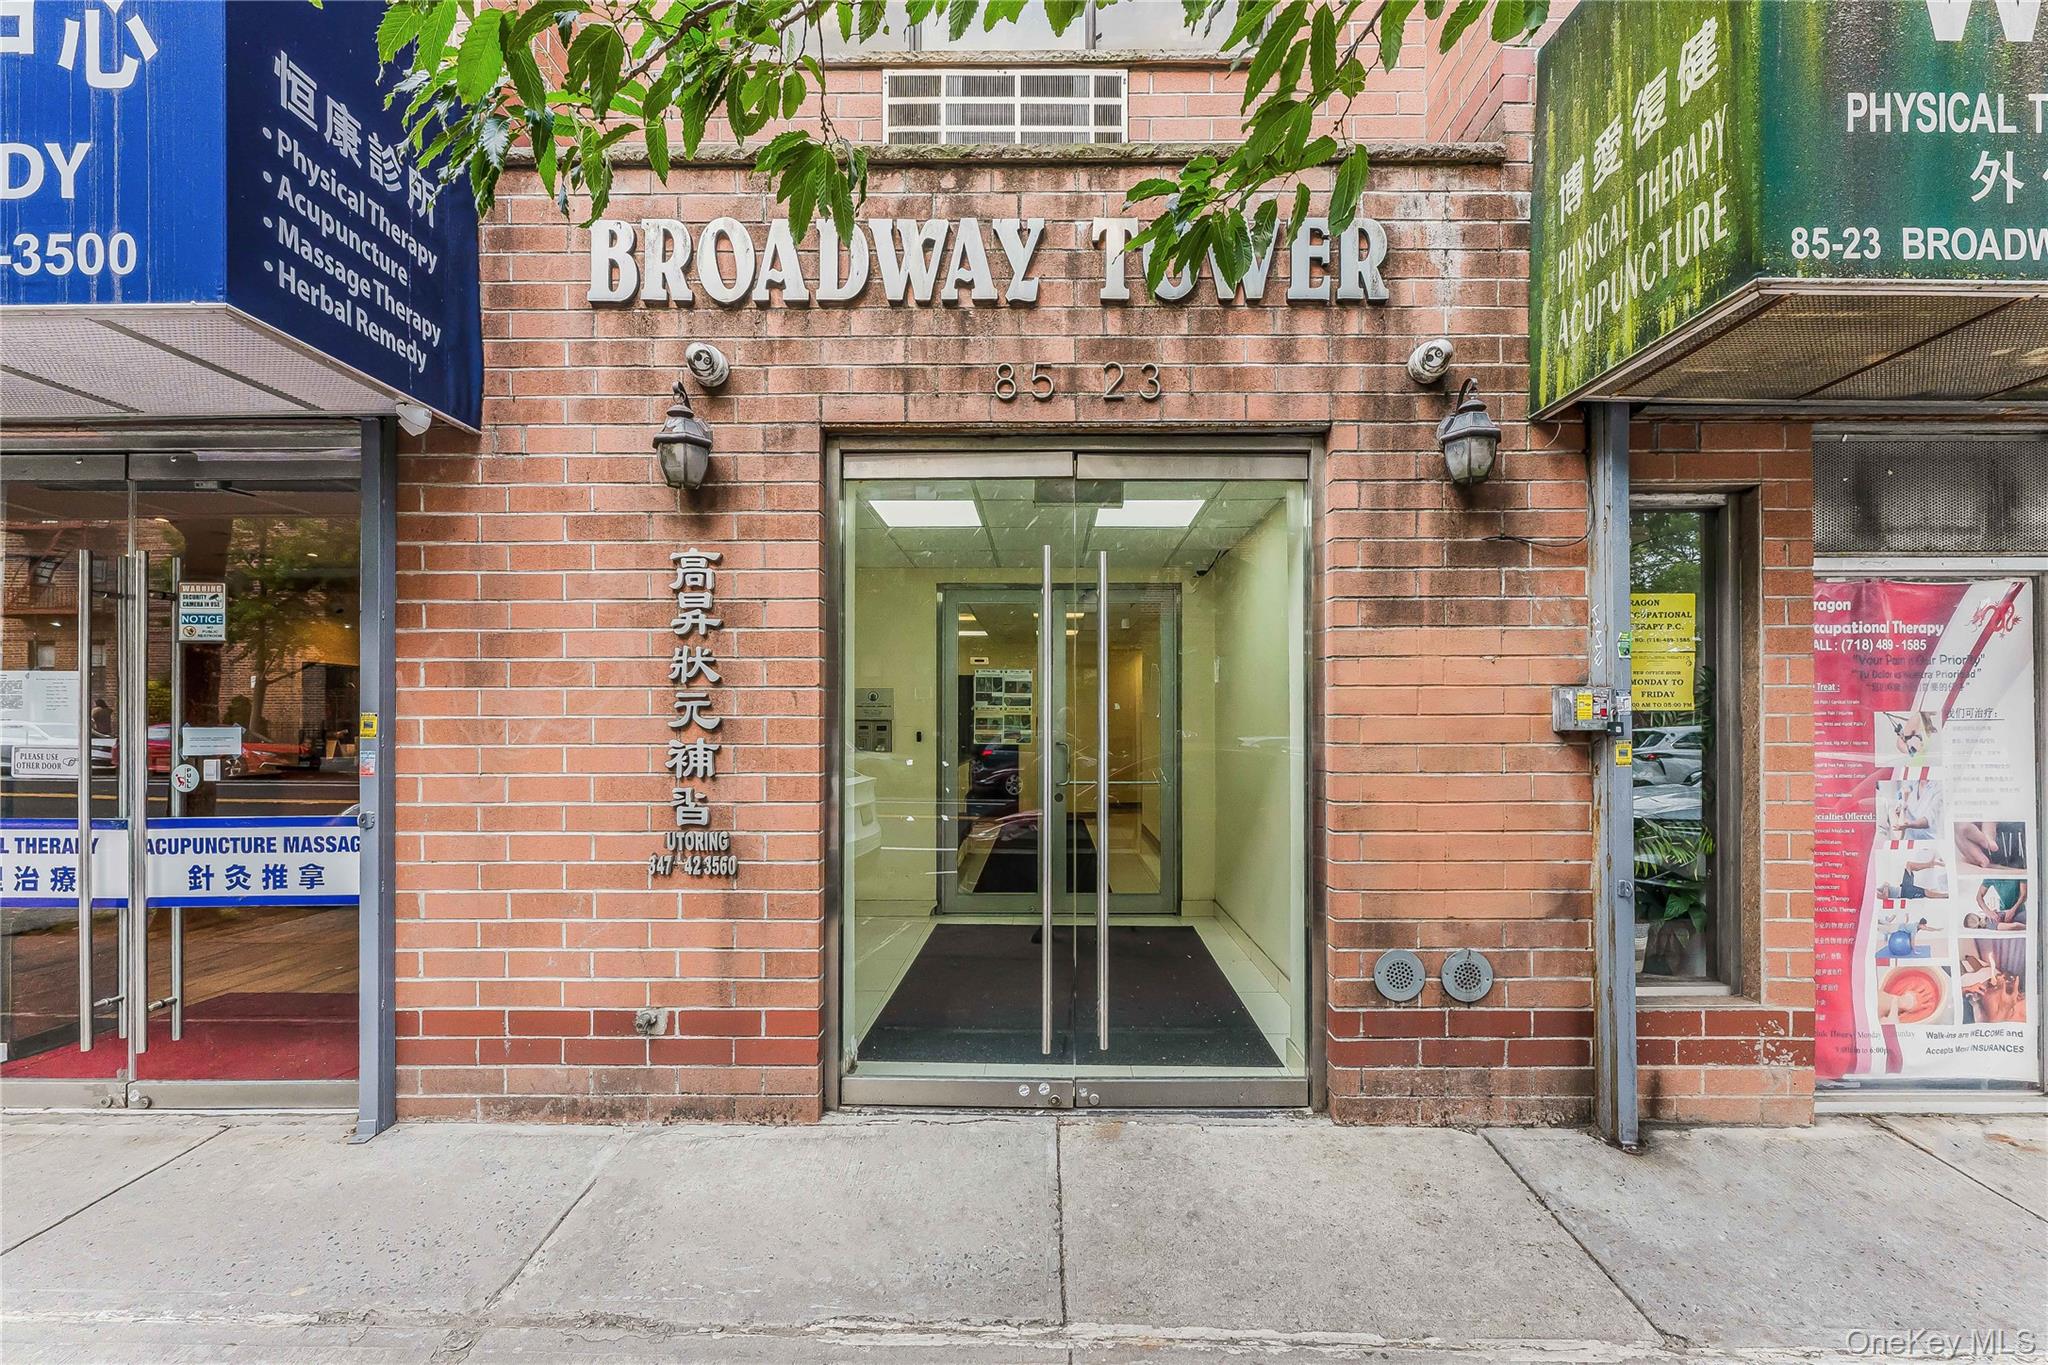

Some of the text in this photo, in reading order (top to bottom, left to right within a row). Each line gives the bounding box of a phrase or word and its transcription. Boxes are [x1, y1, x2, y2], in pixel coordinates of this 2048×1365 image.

[1847, 91, 2018, 135] PHYSICAL
[273, 49, 437, 229] 恒康診所
[0, 142, 92, 200] DY
[1969, 149, 2048, 205] 外
[277, 129, 438, 275] Physical Therapy
[1558, 102, 1729, 296] PHYSICAL THERAPY
[277, 174, 409, 288] Acupuncture
[1790, 226, 1881, 260] 85-23
[587, 216, 1046, 308] BROADWAY
[1556, 185, 1730, 355] ACUPUNCTURE
[277, 216, 442, 348] Massage Therapy
[278, 259, 428, 375] Herbal Remedy
[994, 361, 1161, 401] 85 23
[181, 615, 223, 624] NOTICE
[1892, 620, 1945, 637] Therapy
[1841, 638, 1874, 653] (718)
[1875, 639, 1894, 651] 489
[1901, 639, 1927, 651] 1585
[16, 762, 62, 770] OTHER DOOR
[20, 752, 44, 760] PLEASE
[144, 834, 360, 856] ACUPUNCTURE MASSAG
[0, 866, 76, 893] 治療
[187, 863, 326, 892] 針灸推拿
[648, 854, 674, 876] 347
[1925, 1047, 1954, 1055] Accepts
[1971, 1044, 2024, 1053] INSURANCES
[1926, 1031, 1957, 1040] Walk-ins
[2006, 1029, 2024, 1038] and
